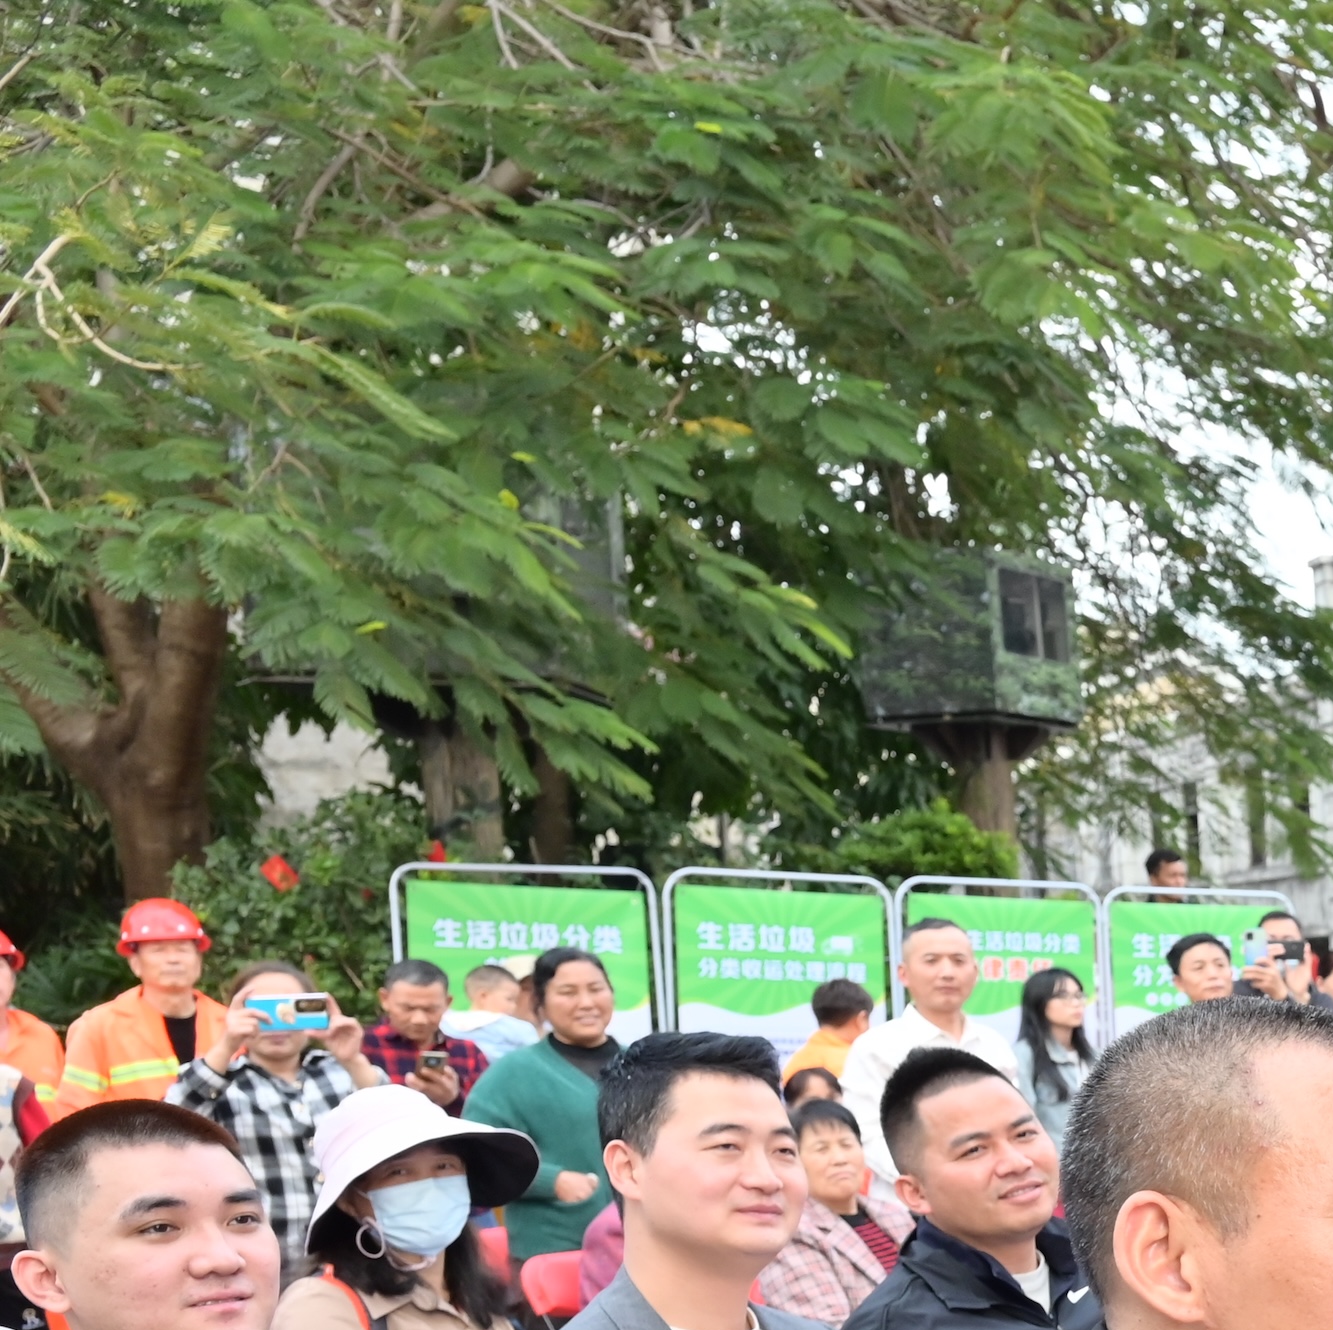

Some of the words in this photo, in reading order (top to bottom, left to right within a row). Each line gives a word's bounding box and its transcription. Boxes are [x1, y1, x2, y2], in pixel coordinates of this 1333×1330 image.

[432, 918, 624, 954] 生活垃圾分类
[696, 921, 815, 954] 生活垃圾
